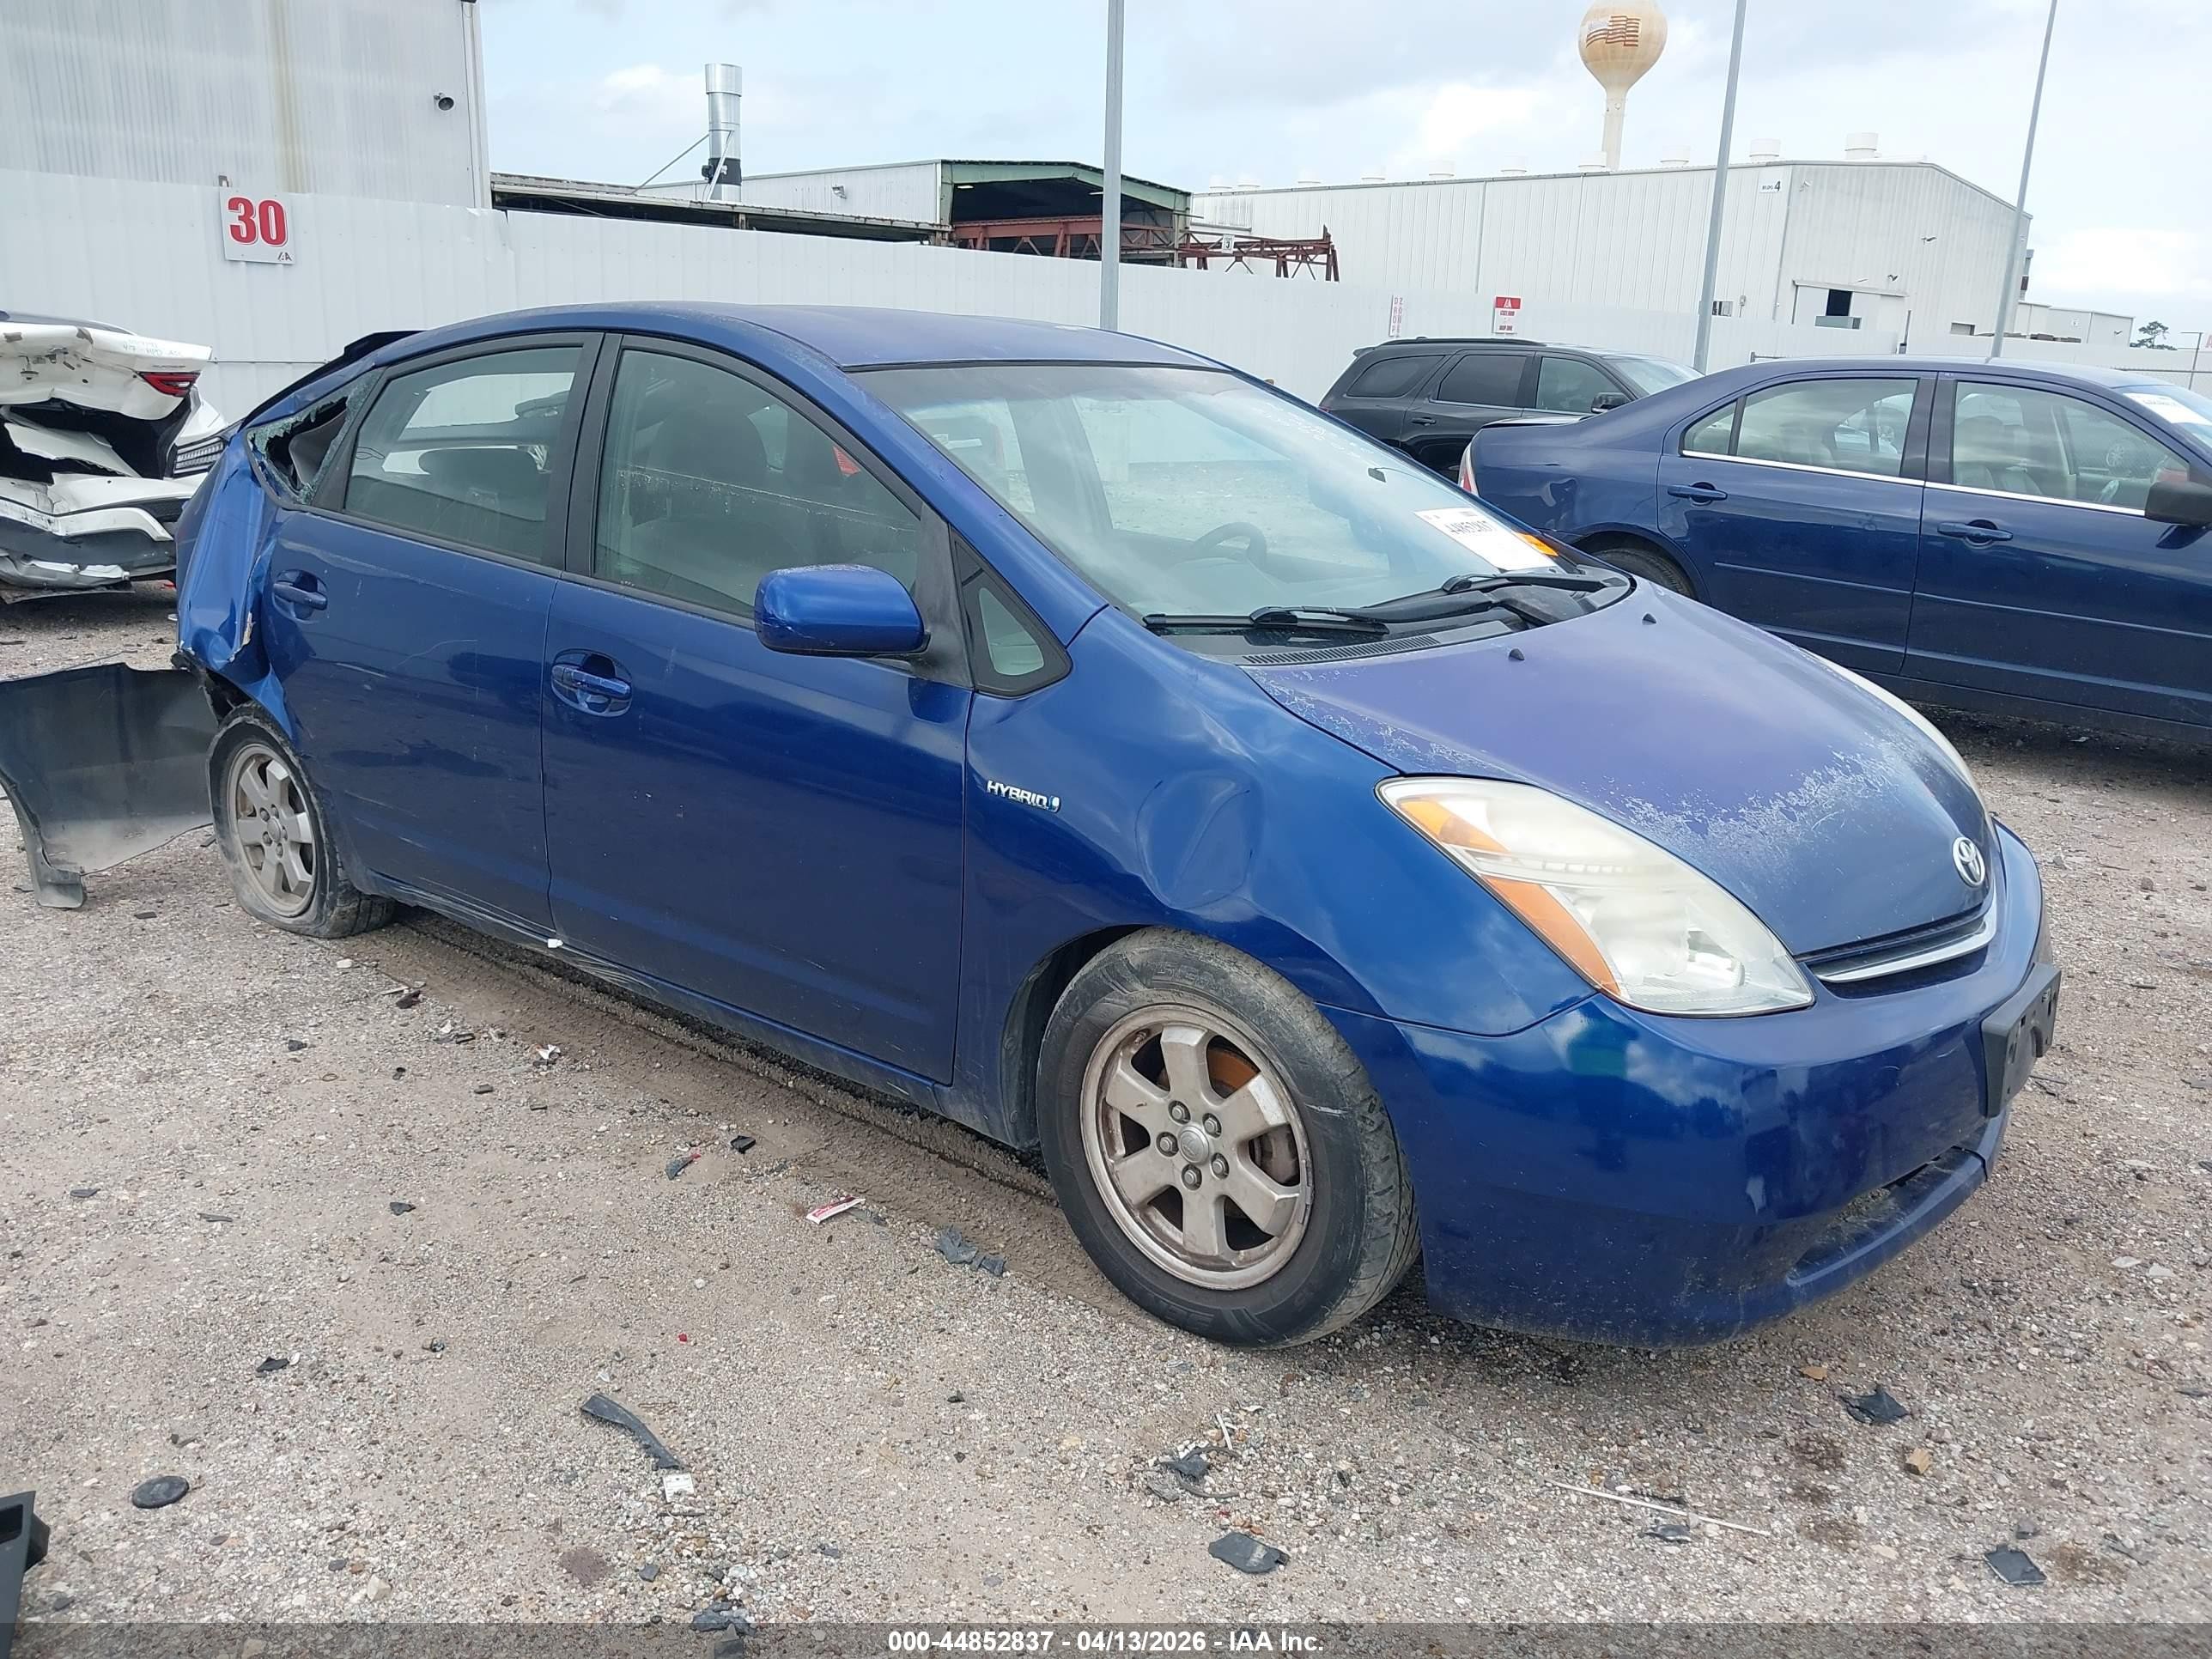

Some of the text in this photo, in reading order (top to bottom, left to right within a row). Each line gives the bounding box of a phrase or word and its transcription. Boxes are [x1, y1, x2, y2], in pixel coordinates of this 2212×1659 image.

[1774, 180, 1781, 191] 4
[227, 197, 288, 247] 30
[987, 780, 1048, 810] HYBRID
